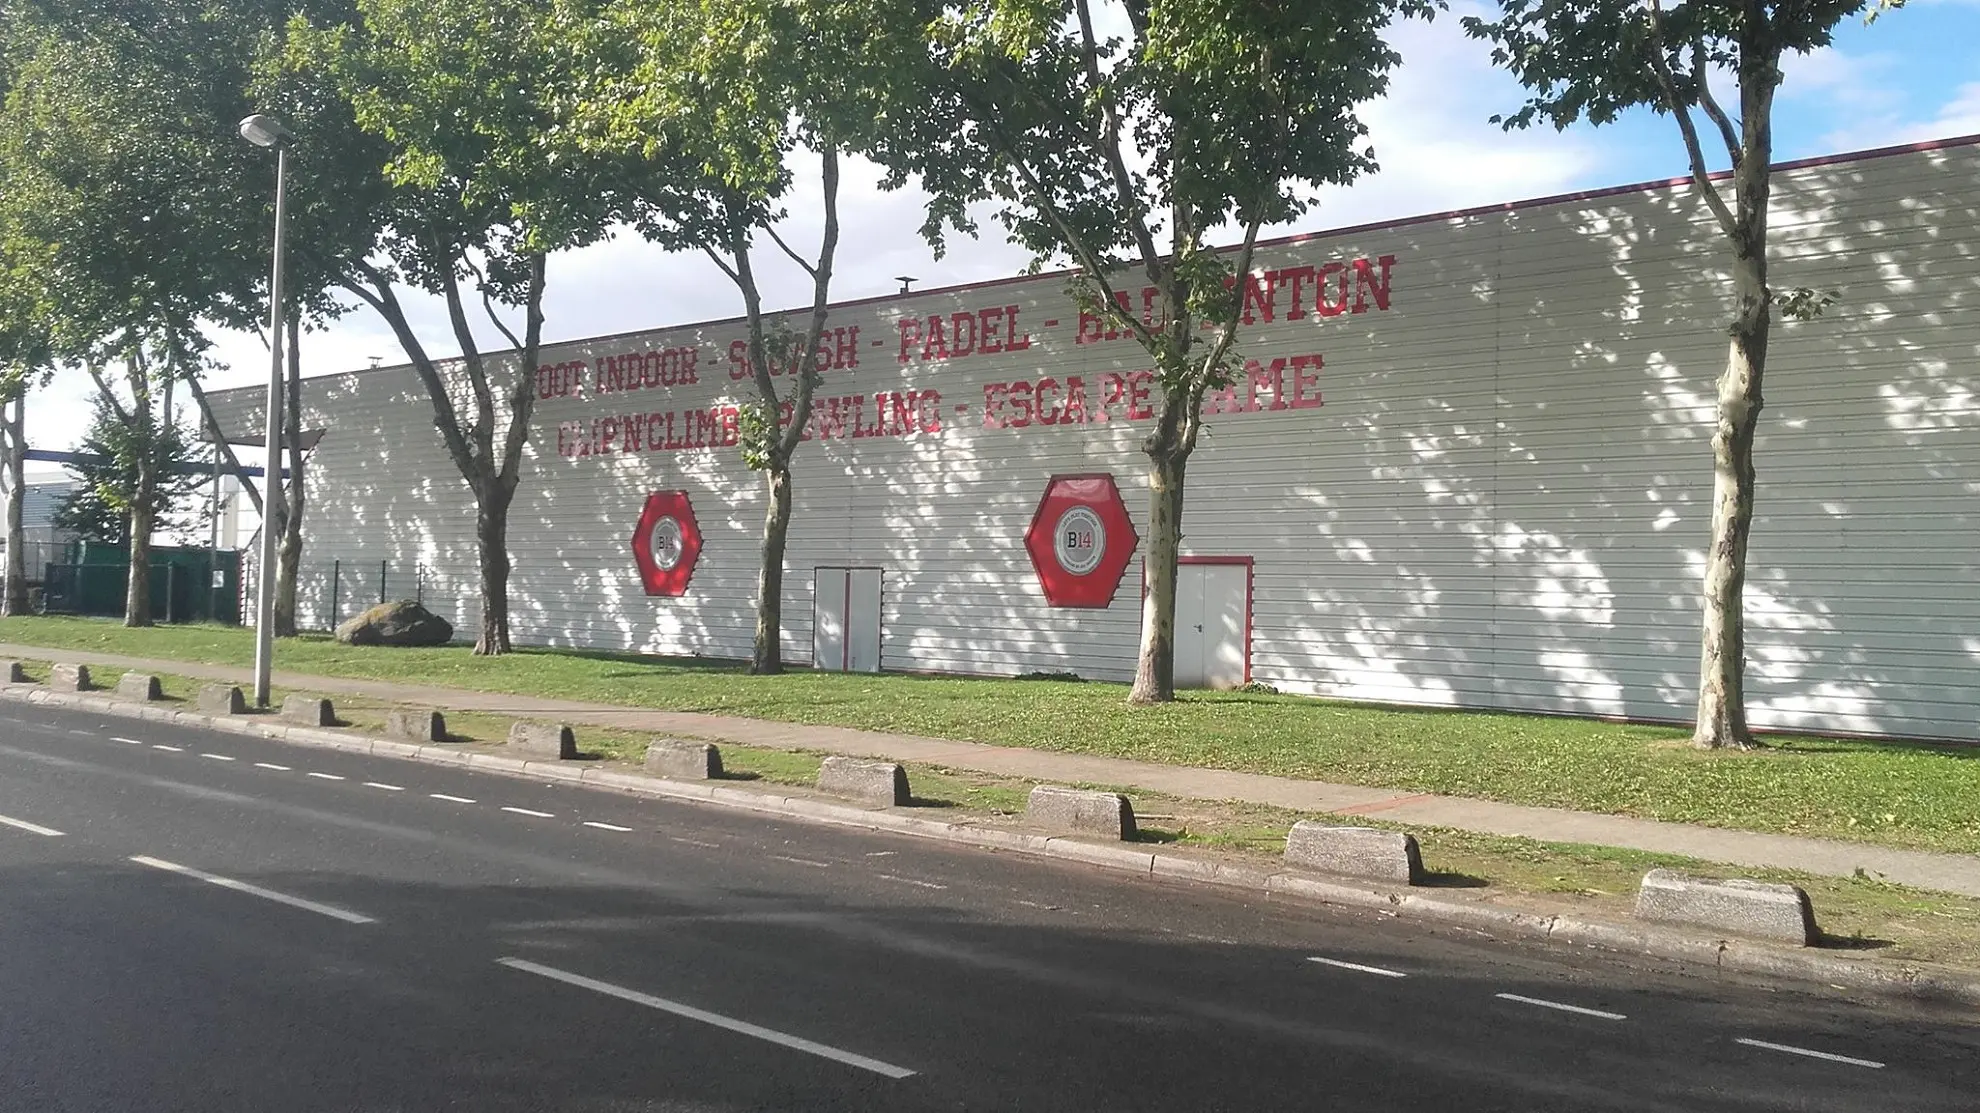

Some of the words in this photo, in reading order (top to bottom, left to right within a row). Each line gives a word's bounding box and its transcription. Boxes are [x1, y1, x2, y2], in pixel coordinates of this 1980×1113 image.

[535, 360, 587, 400] OOT
[596, 346, 699, 394] INDOOR
[728, 325, 860, 380] SASH
[898, 305, 1032, 363] PADEL
[1075, 254, 1397, 344] BADNTON
[774, 389, 942, 441] WLING
[983, 370, 1155, 429] ESCAPE
[1199, 354, 1324, 416] AME
[1067, 531, 1092, 548] B14
